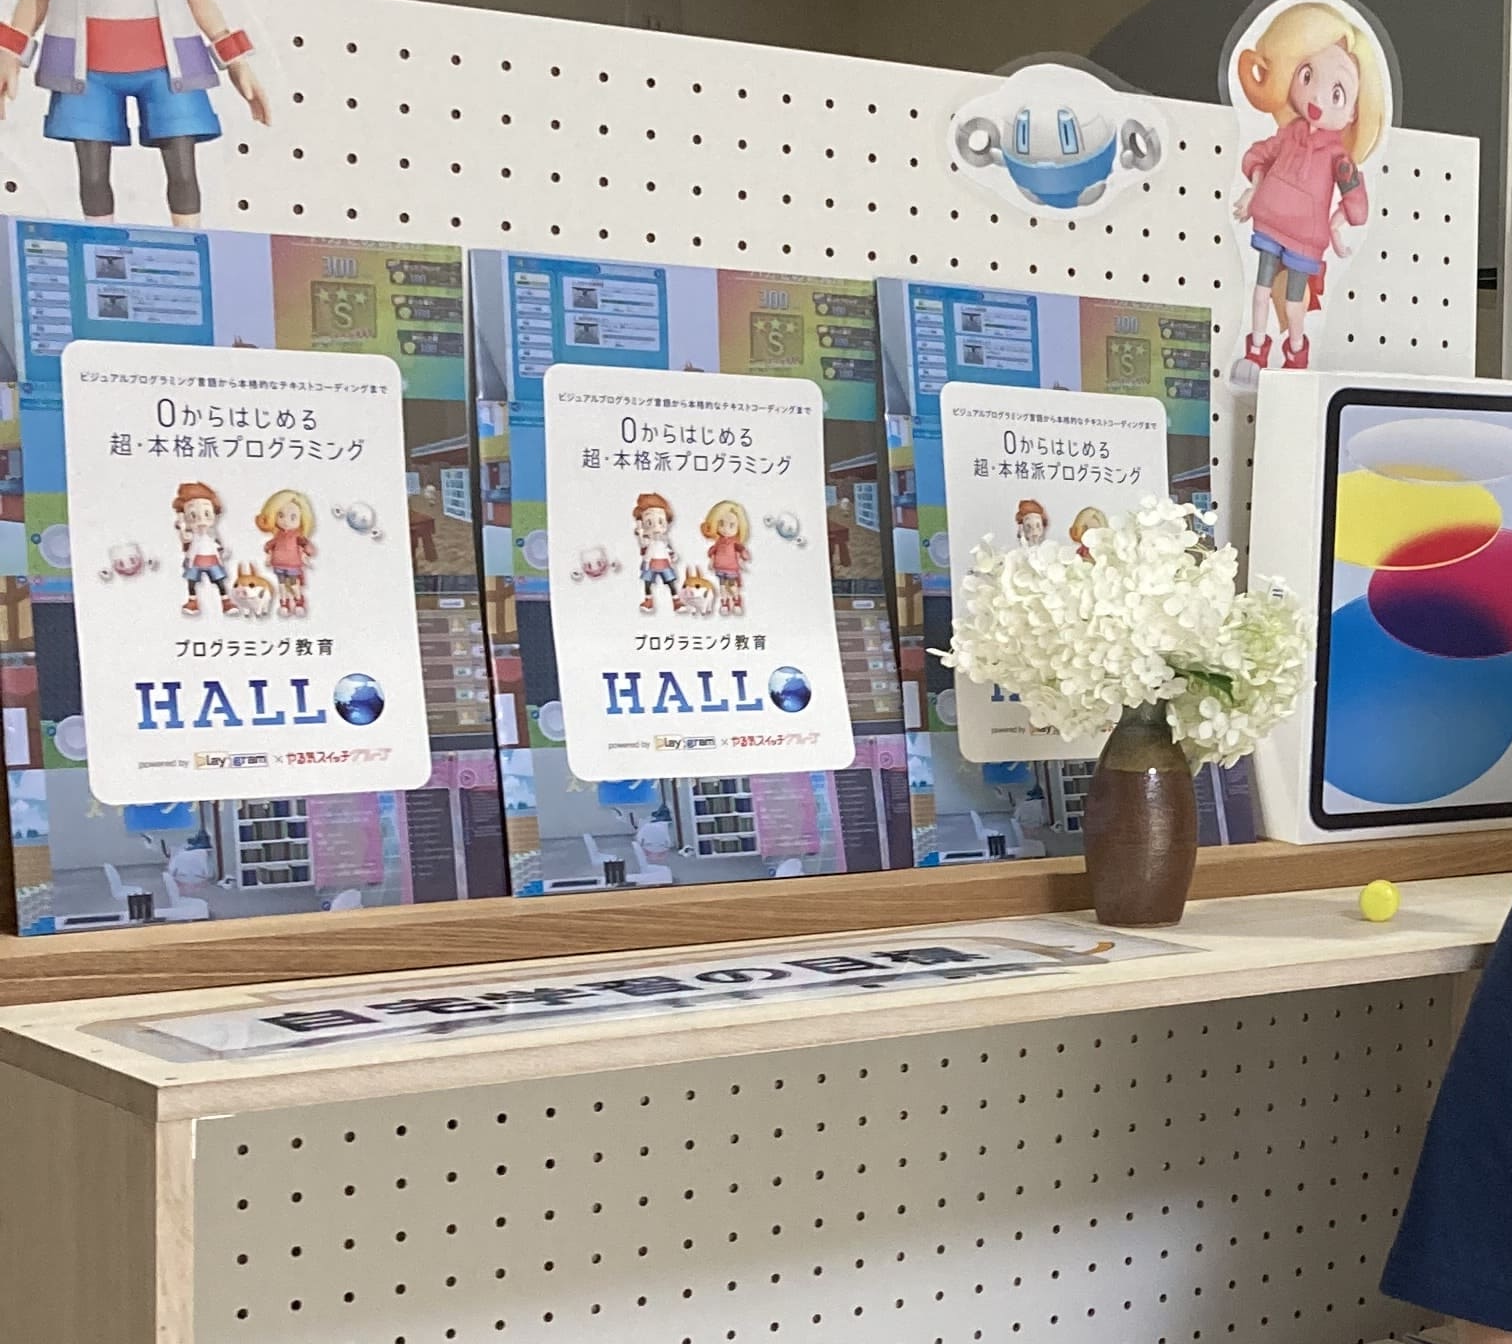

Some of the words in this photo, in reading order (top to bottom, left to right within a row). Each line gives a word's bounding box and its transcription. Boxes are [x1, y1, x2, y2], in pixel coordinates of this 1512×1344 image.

[156, 397, 318, 431] 0からはじめる
[620, 416, 753, 447] 0からはじめる
[1003, 429, 1110, 459] 0からはじめる
[109, 431, 365, 462] 超・本格派プログラミング
[582, 447, 792, 476] 超・本格派プログラミング
[973, 458, 1142, 485] 超・本格派プログラミング
[175, 638, 333, 658] プログラミング教育
[634, 634, 767, 651] プログラミング教育
[138, 759, 176, 770] powered
[178, 759, 190, 769] by
[258, 946, 989, 1032] 自宅学習の目標
